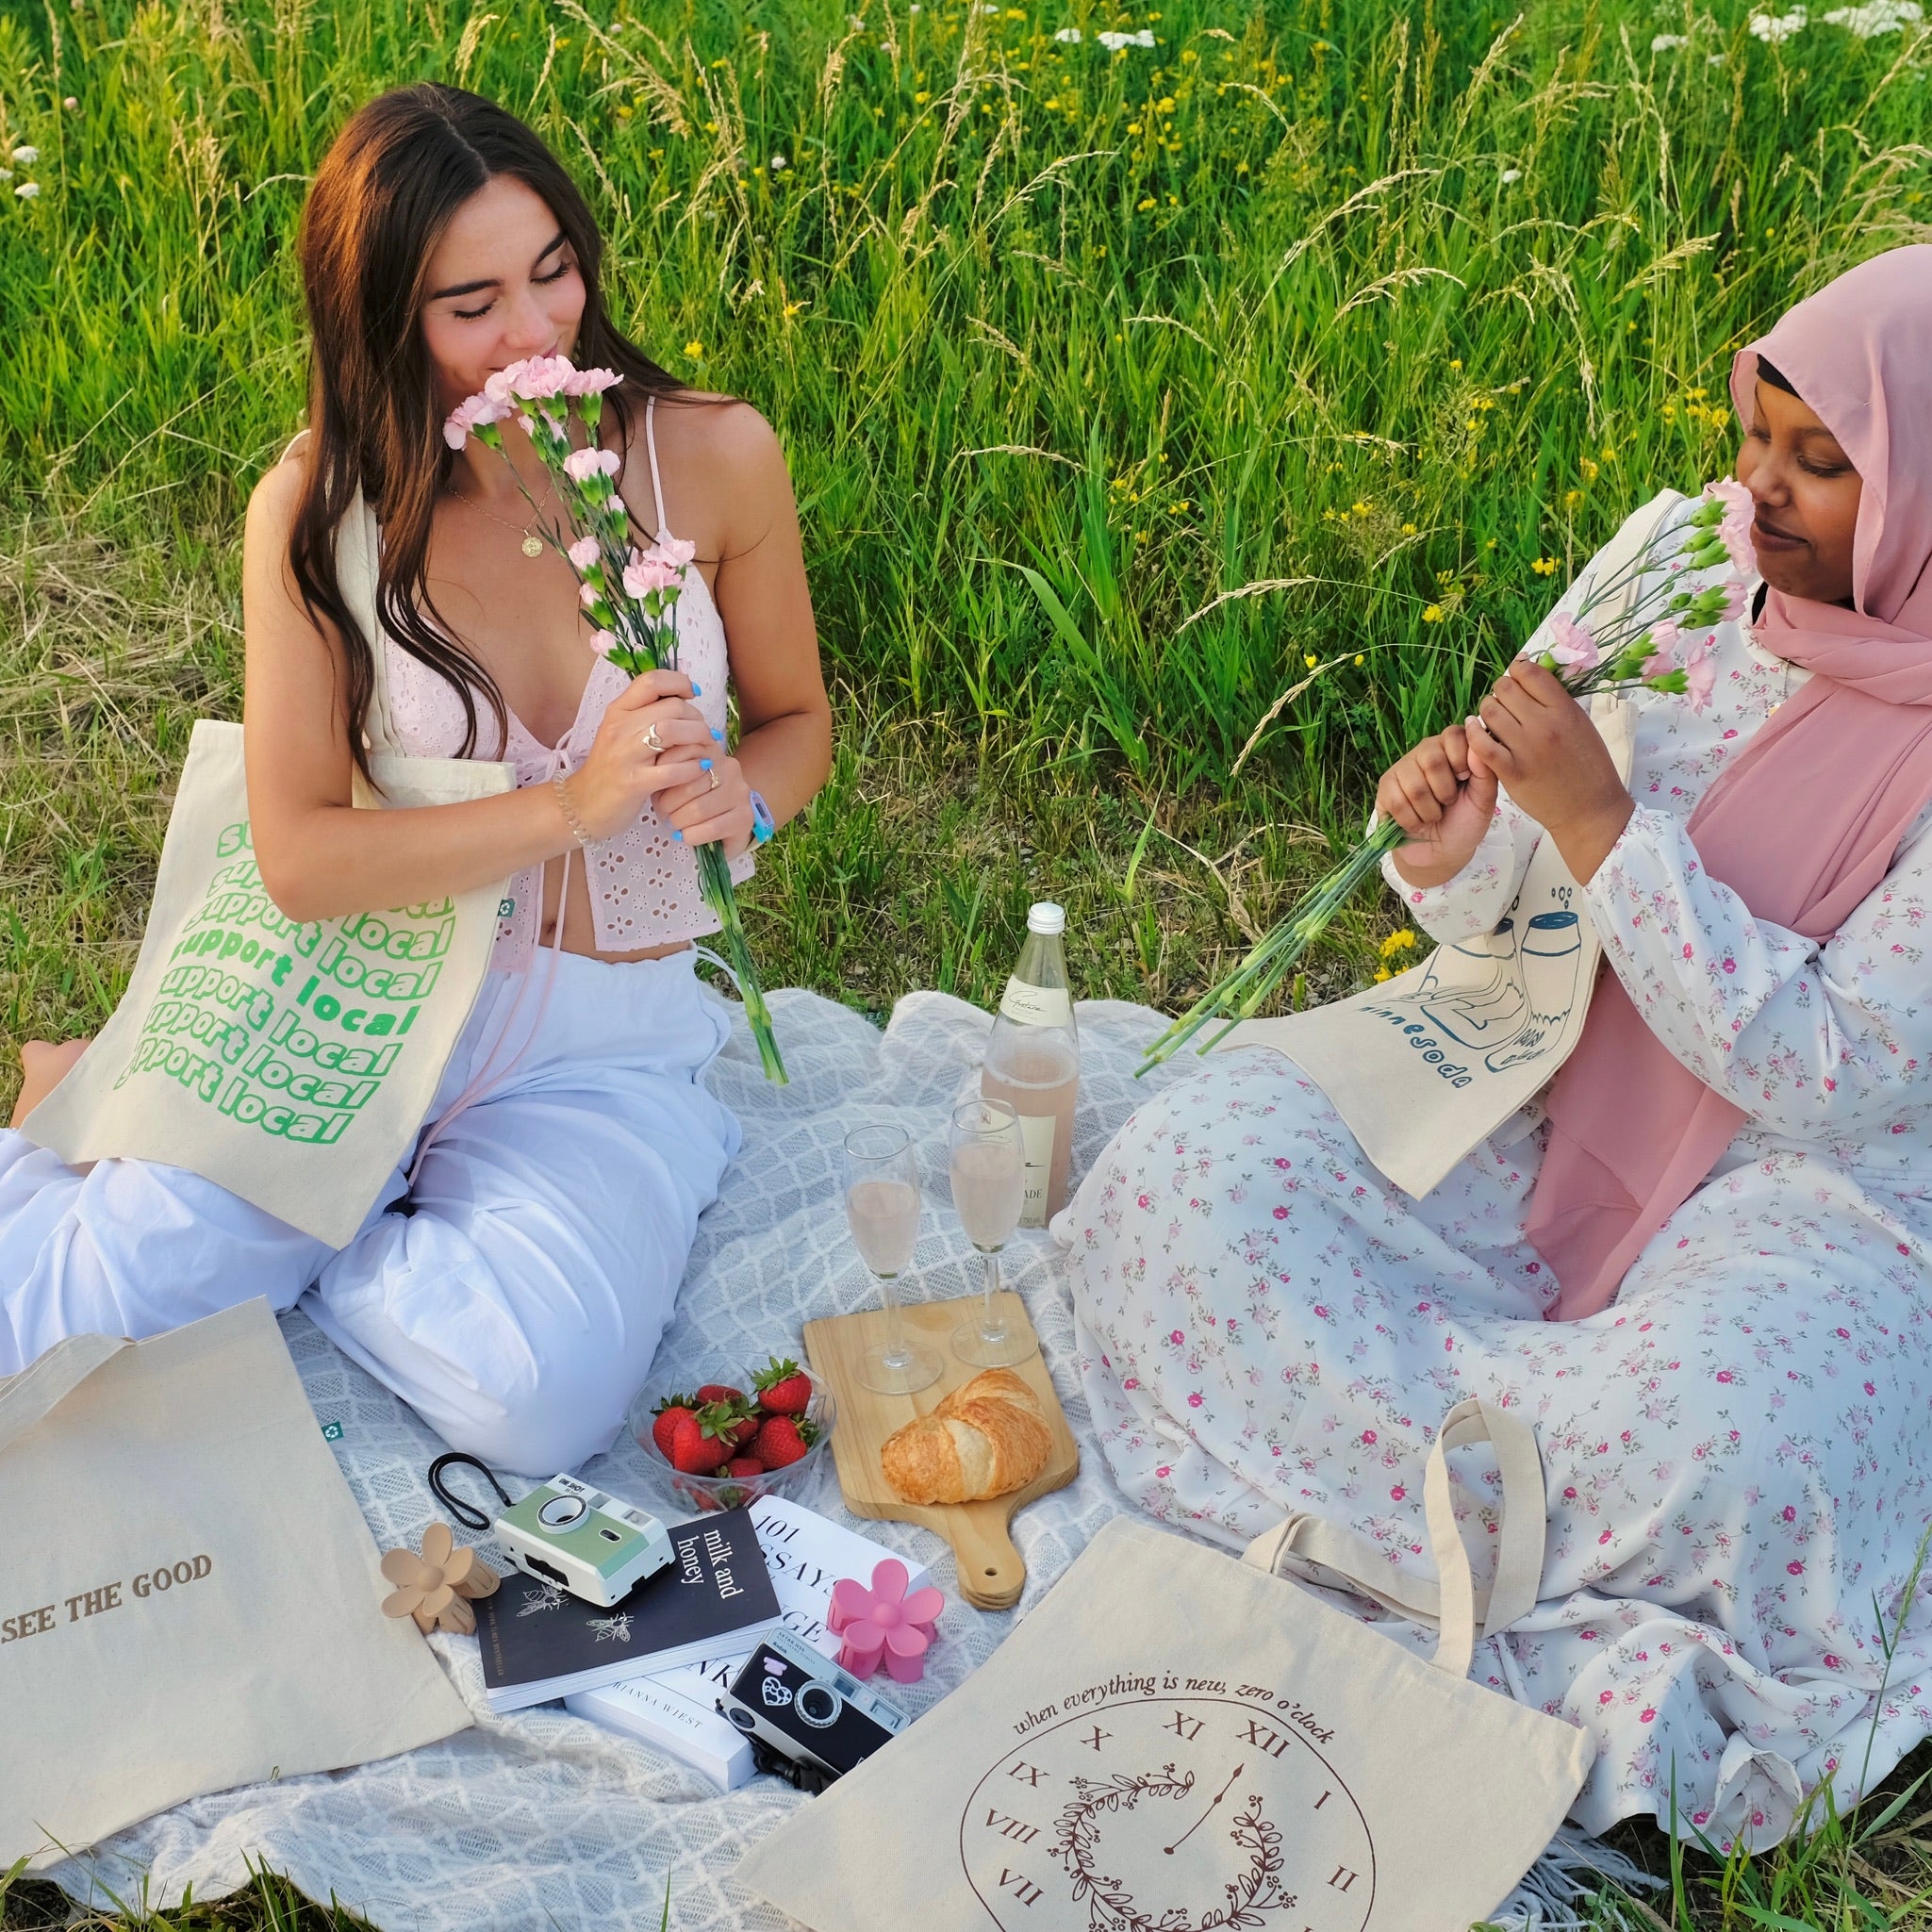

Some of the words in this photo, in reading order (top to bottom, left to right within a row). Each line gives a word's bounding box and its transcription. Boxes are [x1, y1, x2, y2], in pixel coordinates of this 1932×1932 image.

[317, 936, 443, 1000] local
[297, 977, 421, 1037] local
[268, 1008, 404, 1077] local
[241, 1044, 381, 1109] local
[217, 1078, 355, 1145] local
[703, 1528, 734, 1568] milk
[755, 1515, 801, 1544] 101
[677, 1535, 704, 1585] honey
[760, 1544, 837, 1598] SSAY
[1, 1605, 57, 1644] SEE
[64, 1580, 123, 1624] THE
[131, 1554, 213, 1599] GOOD
[714, 1567, 745, 1600] and
[772, 1641, 787, 1654] Kodak
[613, 1680, 658, 1707] RIANNA
[663, 1703, 703, 1729] WIEST
[1013, 1703, 1059, 1736] when
[1063, 1671, 1157, 1711] everything
[1162, 1670, 1179, 1691] is
[1184, 1676, 1228, 1695] new,
[1234, 1680, 1275, 1702] zero
[1277, 1693, 1335, 1745] o'clock
[1080, 1725, 1114, 1752] X
[1162, 1710, 1207, 1742] XI
[1235, 1719, 1291, 1759] XII
[1005, 1760, 1051, 1789] IX
[1313, 1790, 1332, 1811] I
[984, 1808, 1042, 1845] VIII
[998, 1868, 1045, 1908] VII
[1327, 1864, 1360, 1893] II
